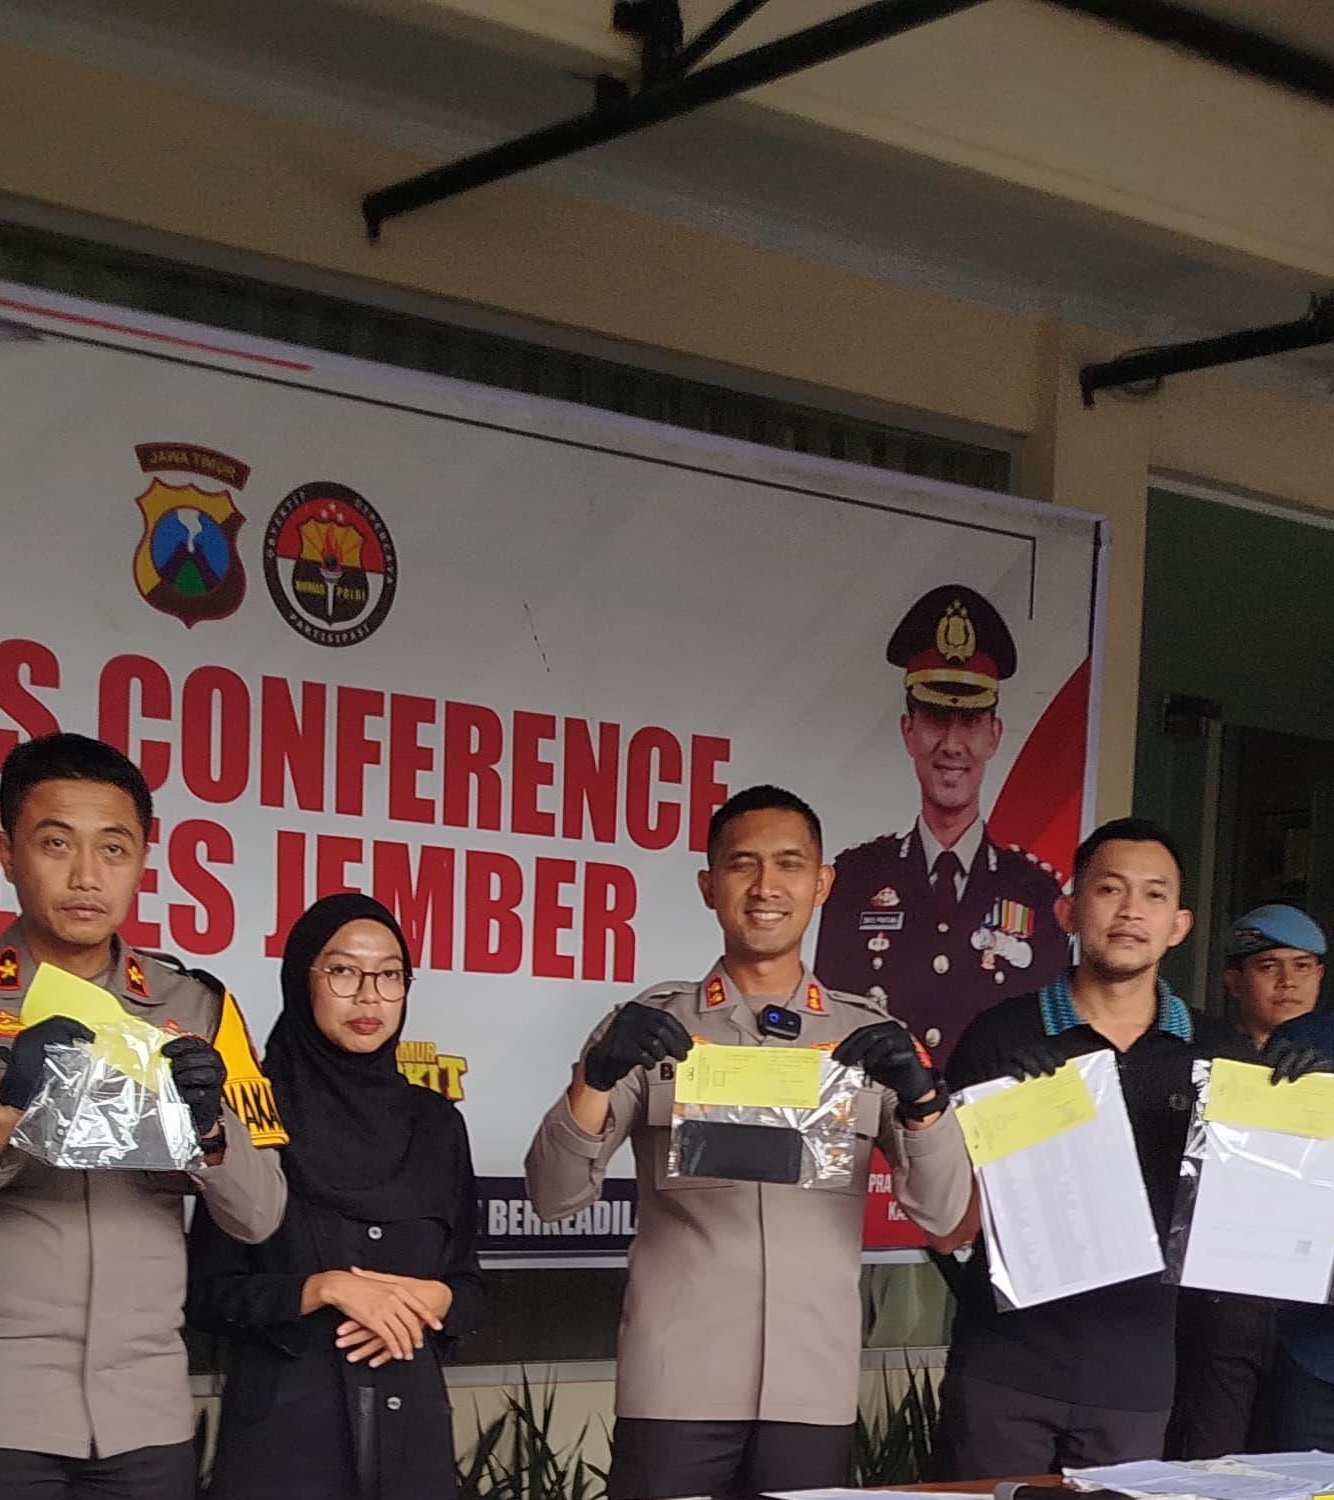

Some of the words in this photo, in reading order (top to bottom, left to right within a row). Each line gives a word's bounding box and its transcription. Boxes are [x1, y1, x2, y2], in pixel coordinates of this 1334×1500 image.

[149, 450, 188, 465] JAWA
[337, 584, 366, 601] POLRI
[98, 654, 731, 852] CONFERENCE
[399, 1041, 435, 1060] MUR
[868, 1173, 892, 1193] PRA
